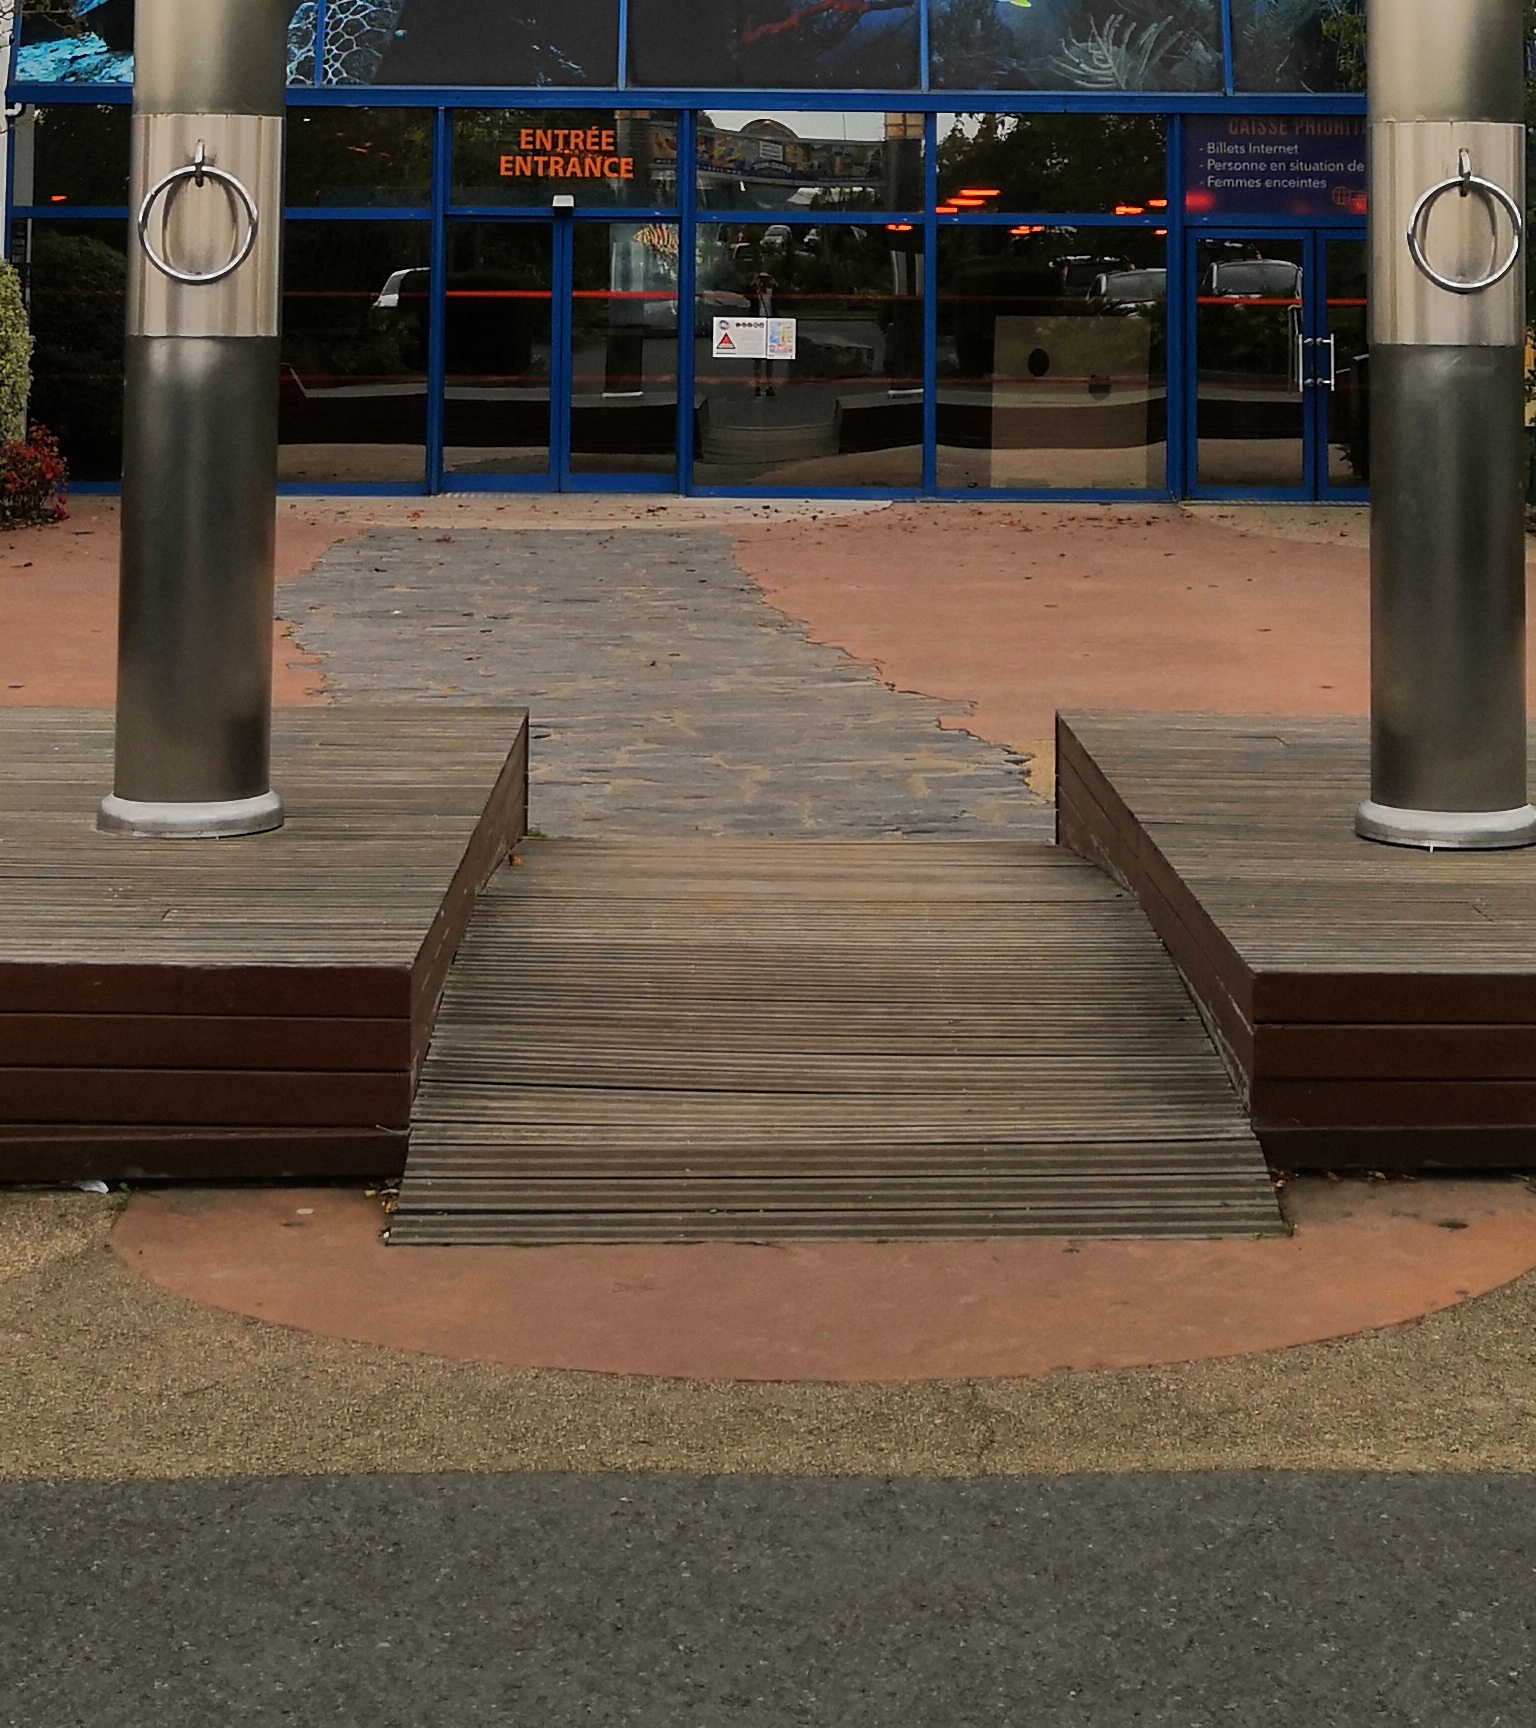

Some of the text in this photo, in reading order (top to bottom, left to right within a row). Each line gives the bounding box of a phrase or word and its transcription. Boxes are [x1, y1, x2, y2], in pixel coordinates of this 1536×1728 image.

[520, 125, 615, 151] ENTRÉE
[1207, 142, 1299, 155] Billets Internet
[500, 155, 634, 179] ENTRANCE
[1207, 159, 1365, 172] Personne en situation de
[1207, 176, 1327, 189] Femmes enceintes
